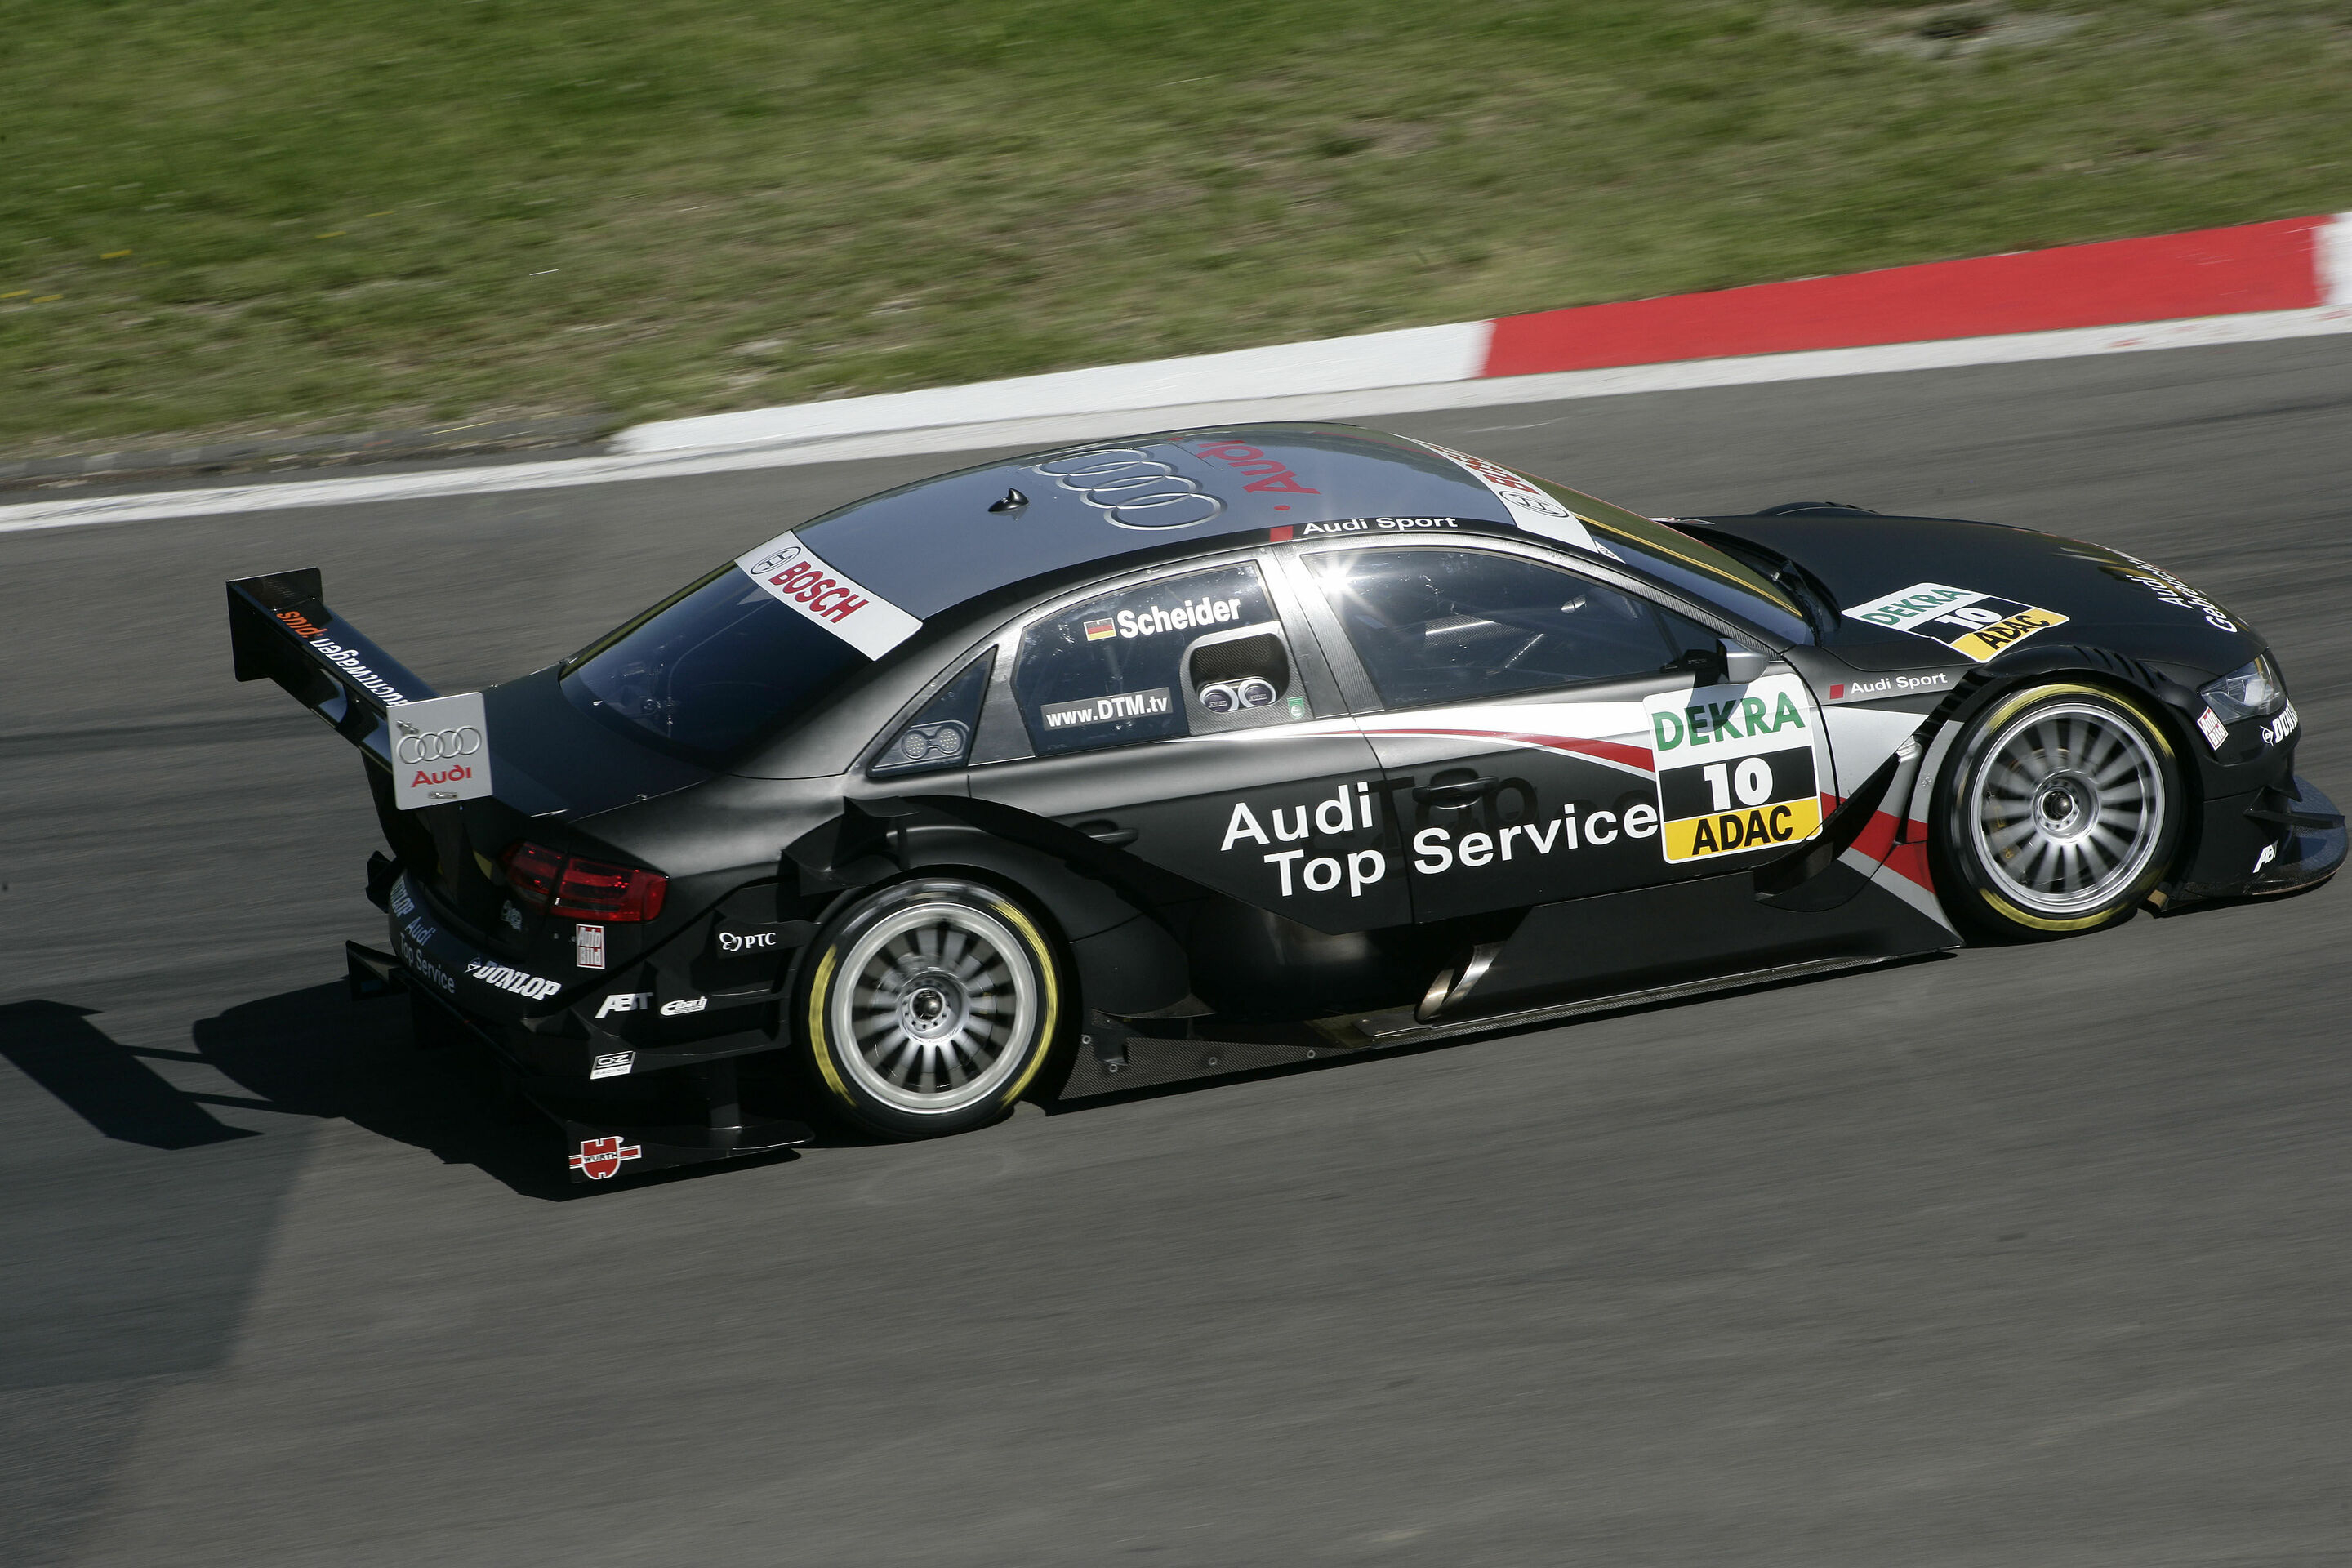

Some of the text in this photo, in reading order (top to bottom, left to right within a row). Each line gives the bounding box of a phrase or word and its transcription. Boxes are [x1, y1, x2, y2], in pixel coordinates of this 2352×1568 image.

[1195, 439, 1321, 493] Audi
[1303, 514, 1458, 535] Audi Sport
[768, 561, 870, 624] BOSCH
[1858, 589, 1972, 626] DEKRA
[1117, 596, 1241, 638] Scheider
[1935, 608, 2002, 629] 10
[1974, 614, 2050, 650] ADAC
[1851, 673, 1948, 694] Audi Sport
[1045, 693, 1169, 728] www.DTM.tv
[1651, 691, 1806, 752] DEKRA
[411, 765, 472, 789] Audi
[1704, 758, 1773, 811] 10
[1221, 780, 1374, 853] Audi
[1692, 804, 1793, 856] ADAC
[1265, 803, 1659, 898] Top Service
[405, 916, 436, 946] Audi
[744, 932, 777, 949] PTC
[399, 932, 456, 994] Top Service
[473, 960, 562, 1000] DUNLOP
[595, 992, 653, 1018] ABT
[597, 1054, 630, 1065] OZ
